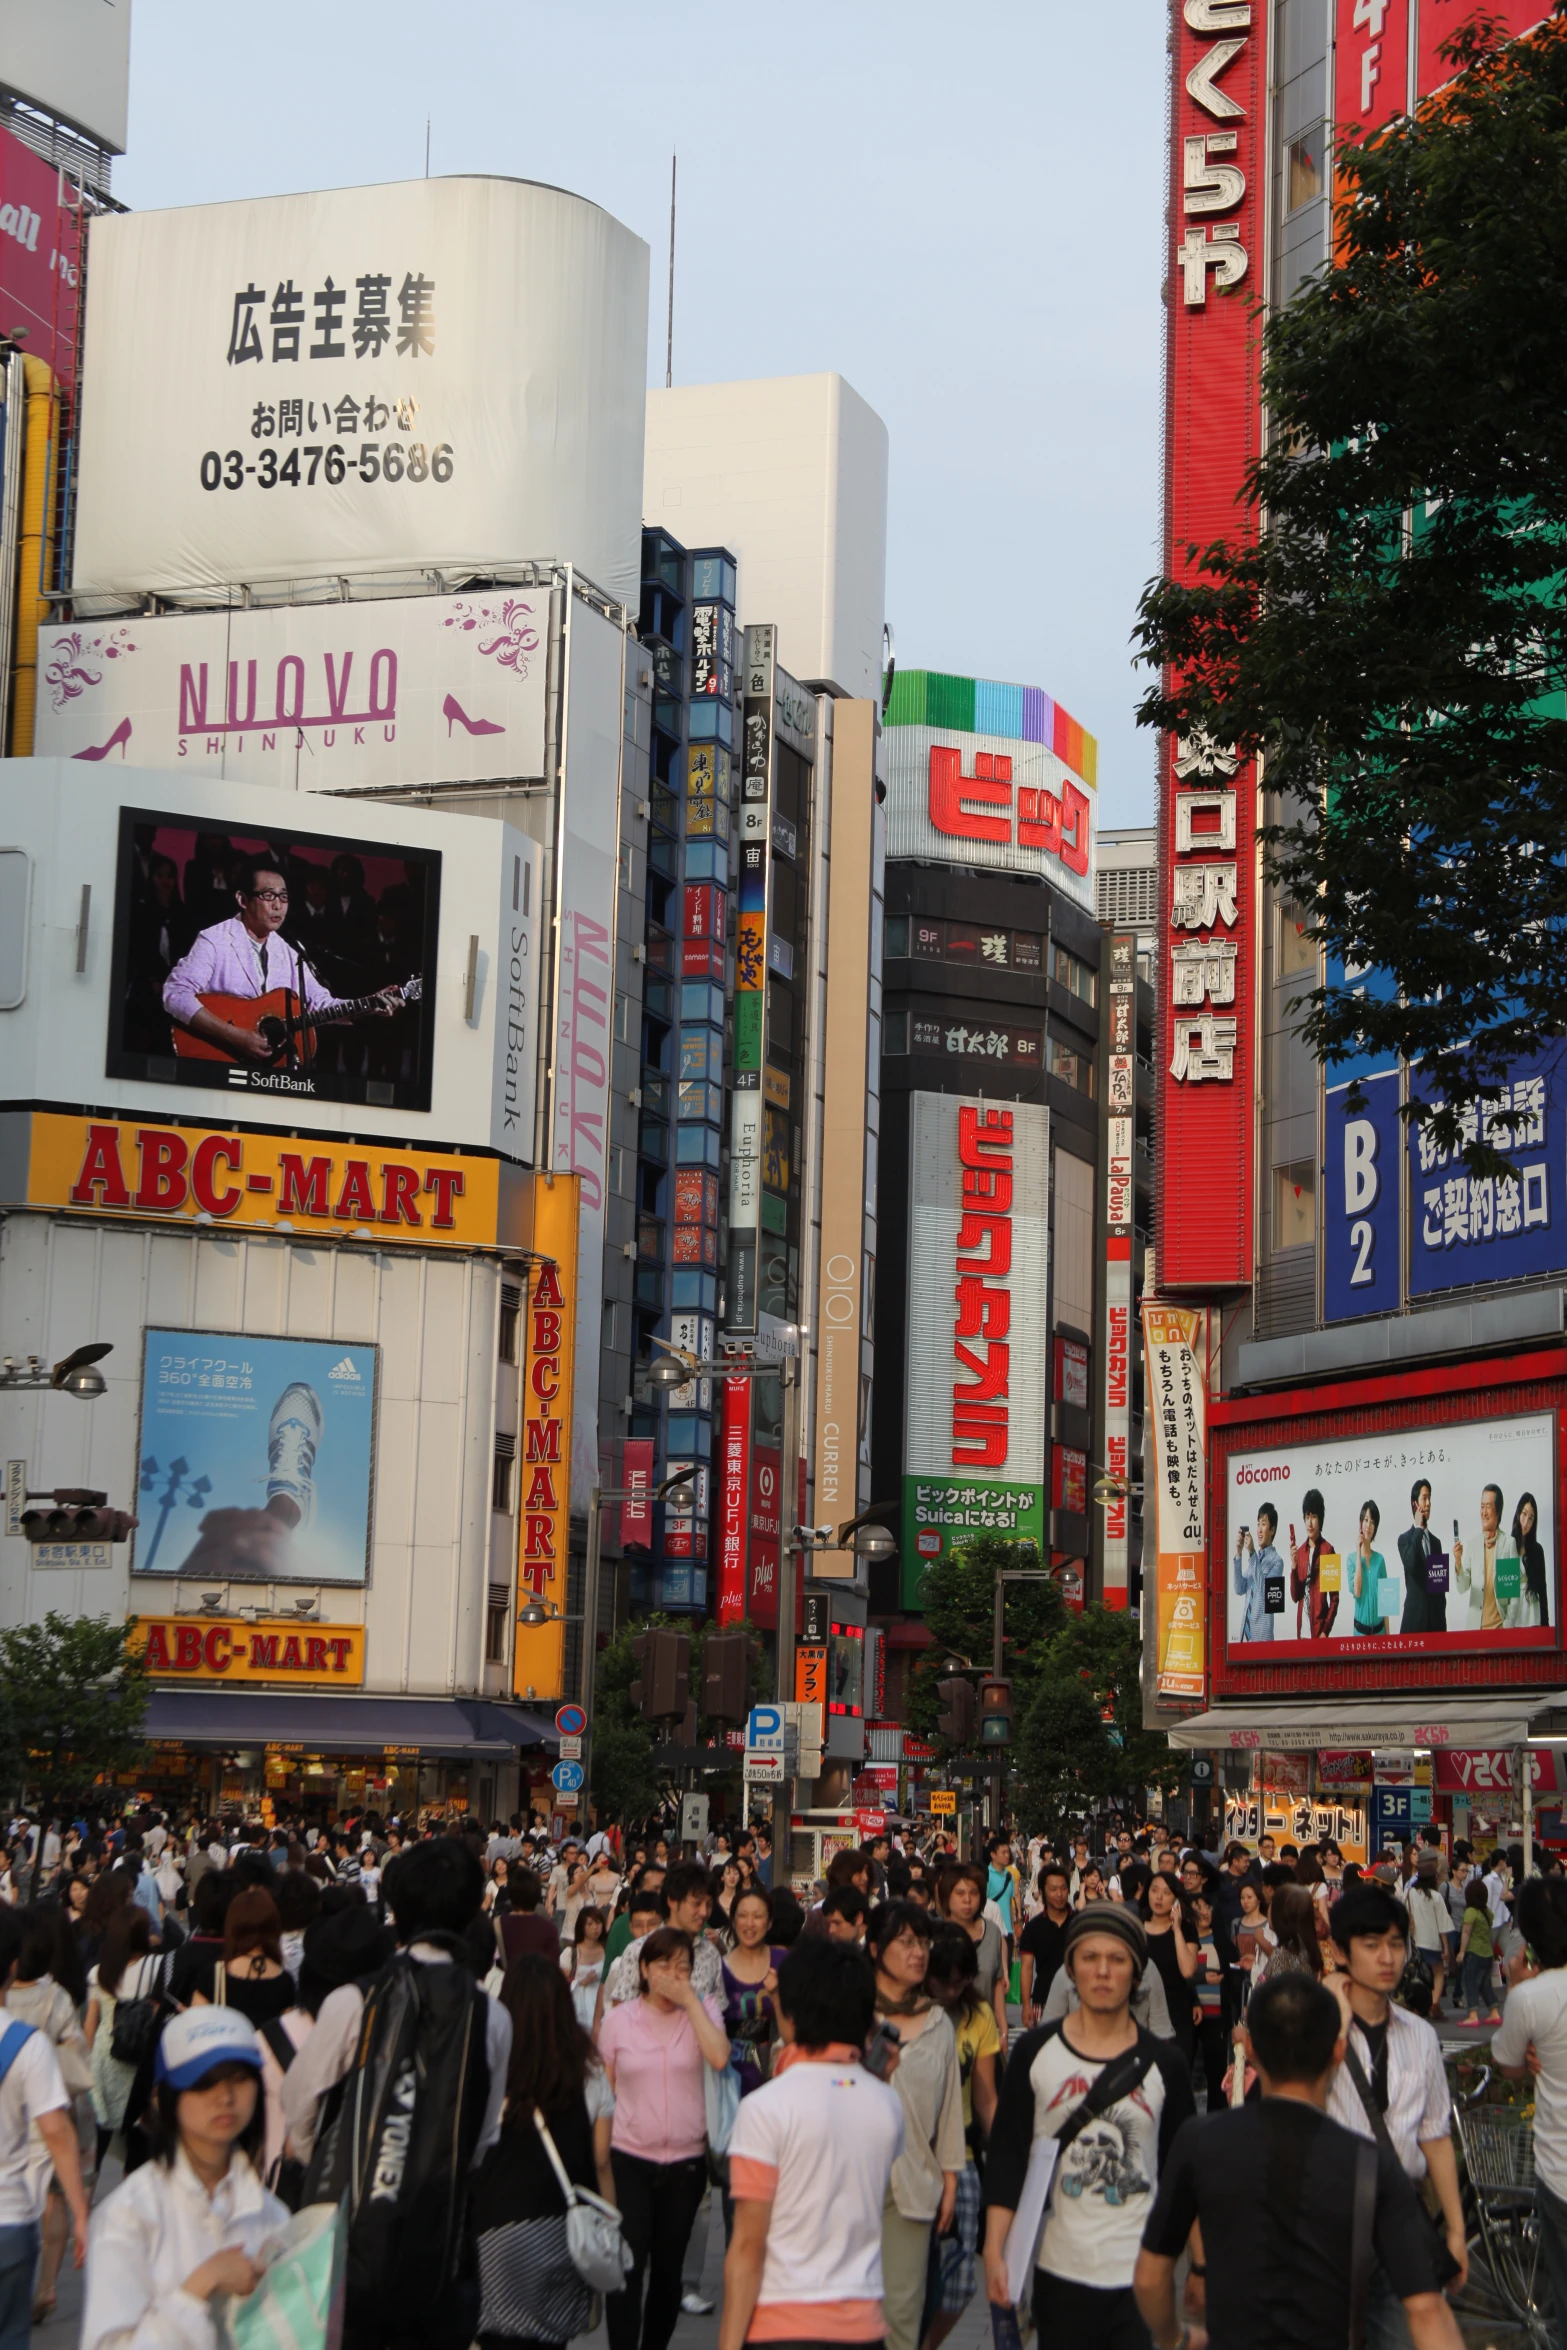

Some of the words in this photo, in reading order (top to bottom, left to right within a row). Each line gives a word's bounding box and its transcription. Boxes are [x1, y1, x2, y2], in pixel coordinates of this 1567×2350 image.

[226, 271, 436, 367] 広告主募集
[250, 393, 420, 439] お問い合わせ
[200, 442, 455, 491] 03-3476-5686
[693, 605, 713, 693] 電撃ホルモン
[178, 648, 398, 736] NUOVO
[708, 678, 717, 694] 9F
[177, 725, 397, 757] SHINJUKU
[745, 814, 762, 828] 8F
[928, 744, 1090, 877] ビック
[692, 886, 702, 935] インド料理
[918, 929, 938, 943] 9F
[1117, 984, 1128, 992] 9F
[503, 926, 529, 1132] SoftBank
[556, 909, 573, 1158] SHINJUK
[914, 1022, 940, 1033] 手作り
[1115, 1003, 1130, 1044] 甘太郎
[944, 1026, 1009, 1060] 甘太郎
[1017, 1039, 1036, 1053] 8F
[1115, 1045, 1127, 1053] 8F
[571, 910, 609, 1212] NUOVO
[250, 1072, 316, 1094] SoftBank
[736, 1073, 756, 1087] 4F
[70, 1123, 466, 1228] ABC-MART
[738, 1122, 757, 1207] Euphoria
[1110, 1156, 1130, 1174] La
[1109, 1177, 1130, 1222] Pausa
[1344, 1118, 1378, 1284] B2
[1422, 1162, 1549, 1247] ご契約窓口
[1114, 1227, 1126, 1236] 6F
[735, 1250, 745, 1323] www.euphoria.jp
[951, 1105, 1014, 1468] ビックカメラ
[1153, 1328, 1188, 1343] on
[159, 1355, 254, 1374] クライマクール
[824, 1335, 834, 1382] SHINJUKU
[1107, 1307, 1128, 1408] ビックカメラ
[158, 1371, 254, 1390] 360°全面空冷
[328, 1371, 361, 1381] adidas
[685, 1400, 695, 1408] 4F
[824, 1383, 833, 1414] MARUI
[523, 1263, 564, 1603] ABC-MART
[1158, 1349, 1182, 1507] もちろん電話も映像も。
[822, 1422, 840, 1502] CURREN
[1314, 1448, 1451, 1477] あなたのドコモが、きっとある。
[1235, 1463, 1291, 1486] docomo
[723, 1425, 743, 1569] 三菱東京UFJ銀行
[915, 1485, 1036, 1510] ビックポイントが
[1106, 1436, 1128, 1540] ビックメラ
[671, 1520, 686, 1530] 3F
[751, 1514, 780, 1535] 東京UFJ
[914, 1505, 1016, 1528] Suicaになる!
[38, 1545, 105, 1558] 新宿駅東口
[752, 1554, 774, 1596] plus
[1428, 1568, 1448, 1578] SMART
[719, 1590, 743, 1609] plus
[1267, 1591, 1283, 1599] PRO
[1167, 1621, 1200, 1629] サービス
[144, 1623, 353, 1672] ABC-MART
[799, 1649, 825, 1659] 大黒屋
[1165, 1659, 1198, 1669] サービス
[749, 1707, 781, 1748] P
[1229, 1730, 1261, 1748] さくらや
[1328, 1730, 1406, 1743] http://www.sakuraya.co.jp
[1413, 1725, 1450, 1745] さくらや
[146, 1739, 185, 1749] BC-MART
[264, 1742, 304, 1752] ABC-MART
[383, 1745, 421, 1755] ABC-MART
[559, 1767, 572, 1788] P
[1472, 1751, 1542, 1788] さく
[1382, 1793, 1407, 1817] 3F
[368, 2113, 414, 2205] YONEX
